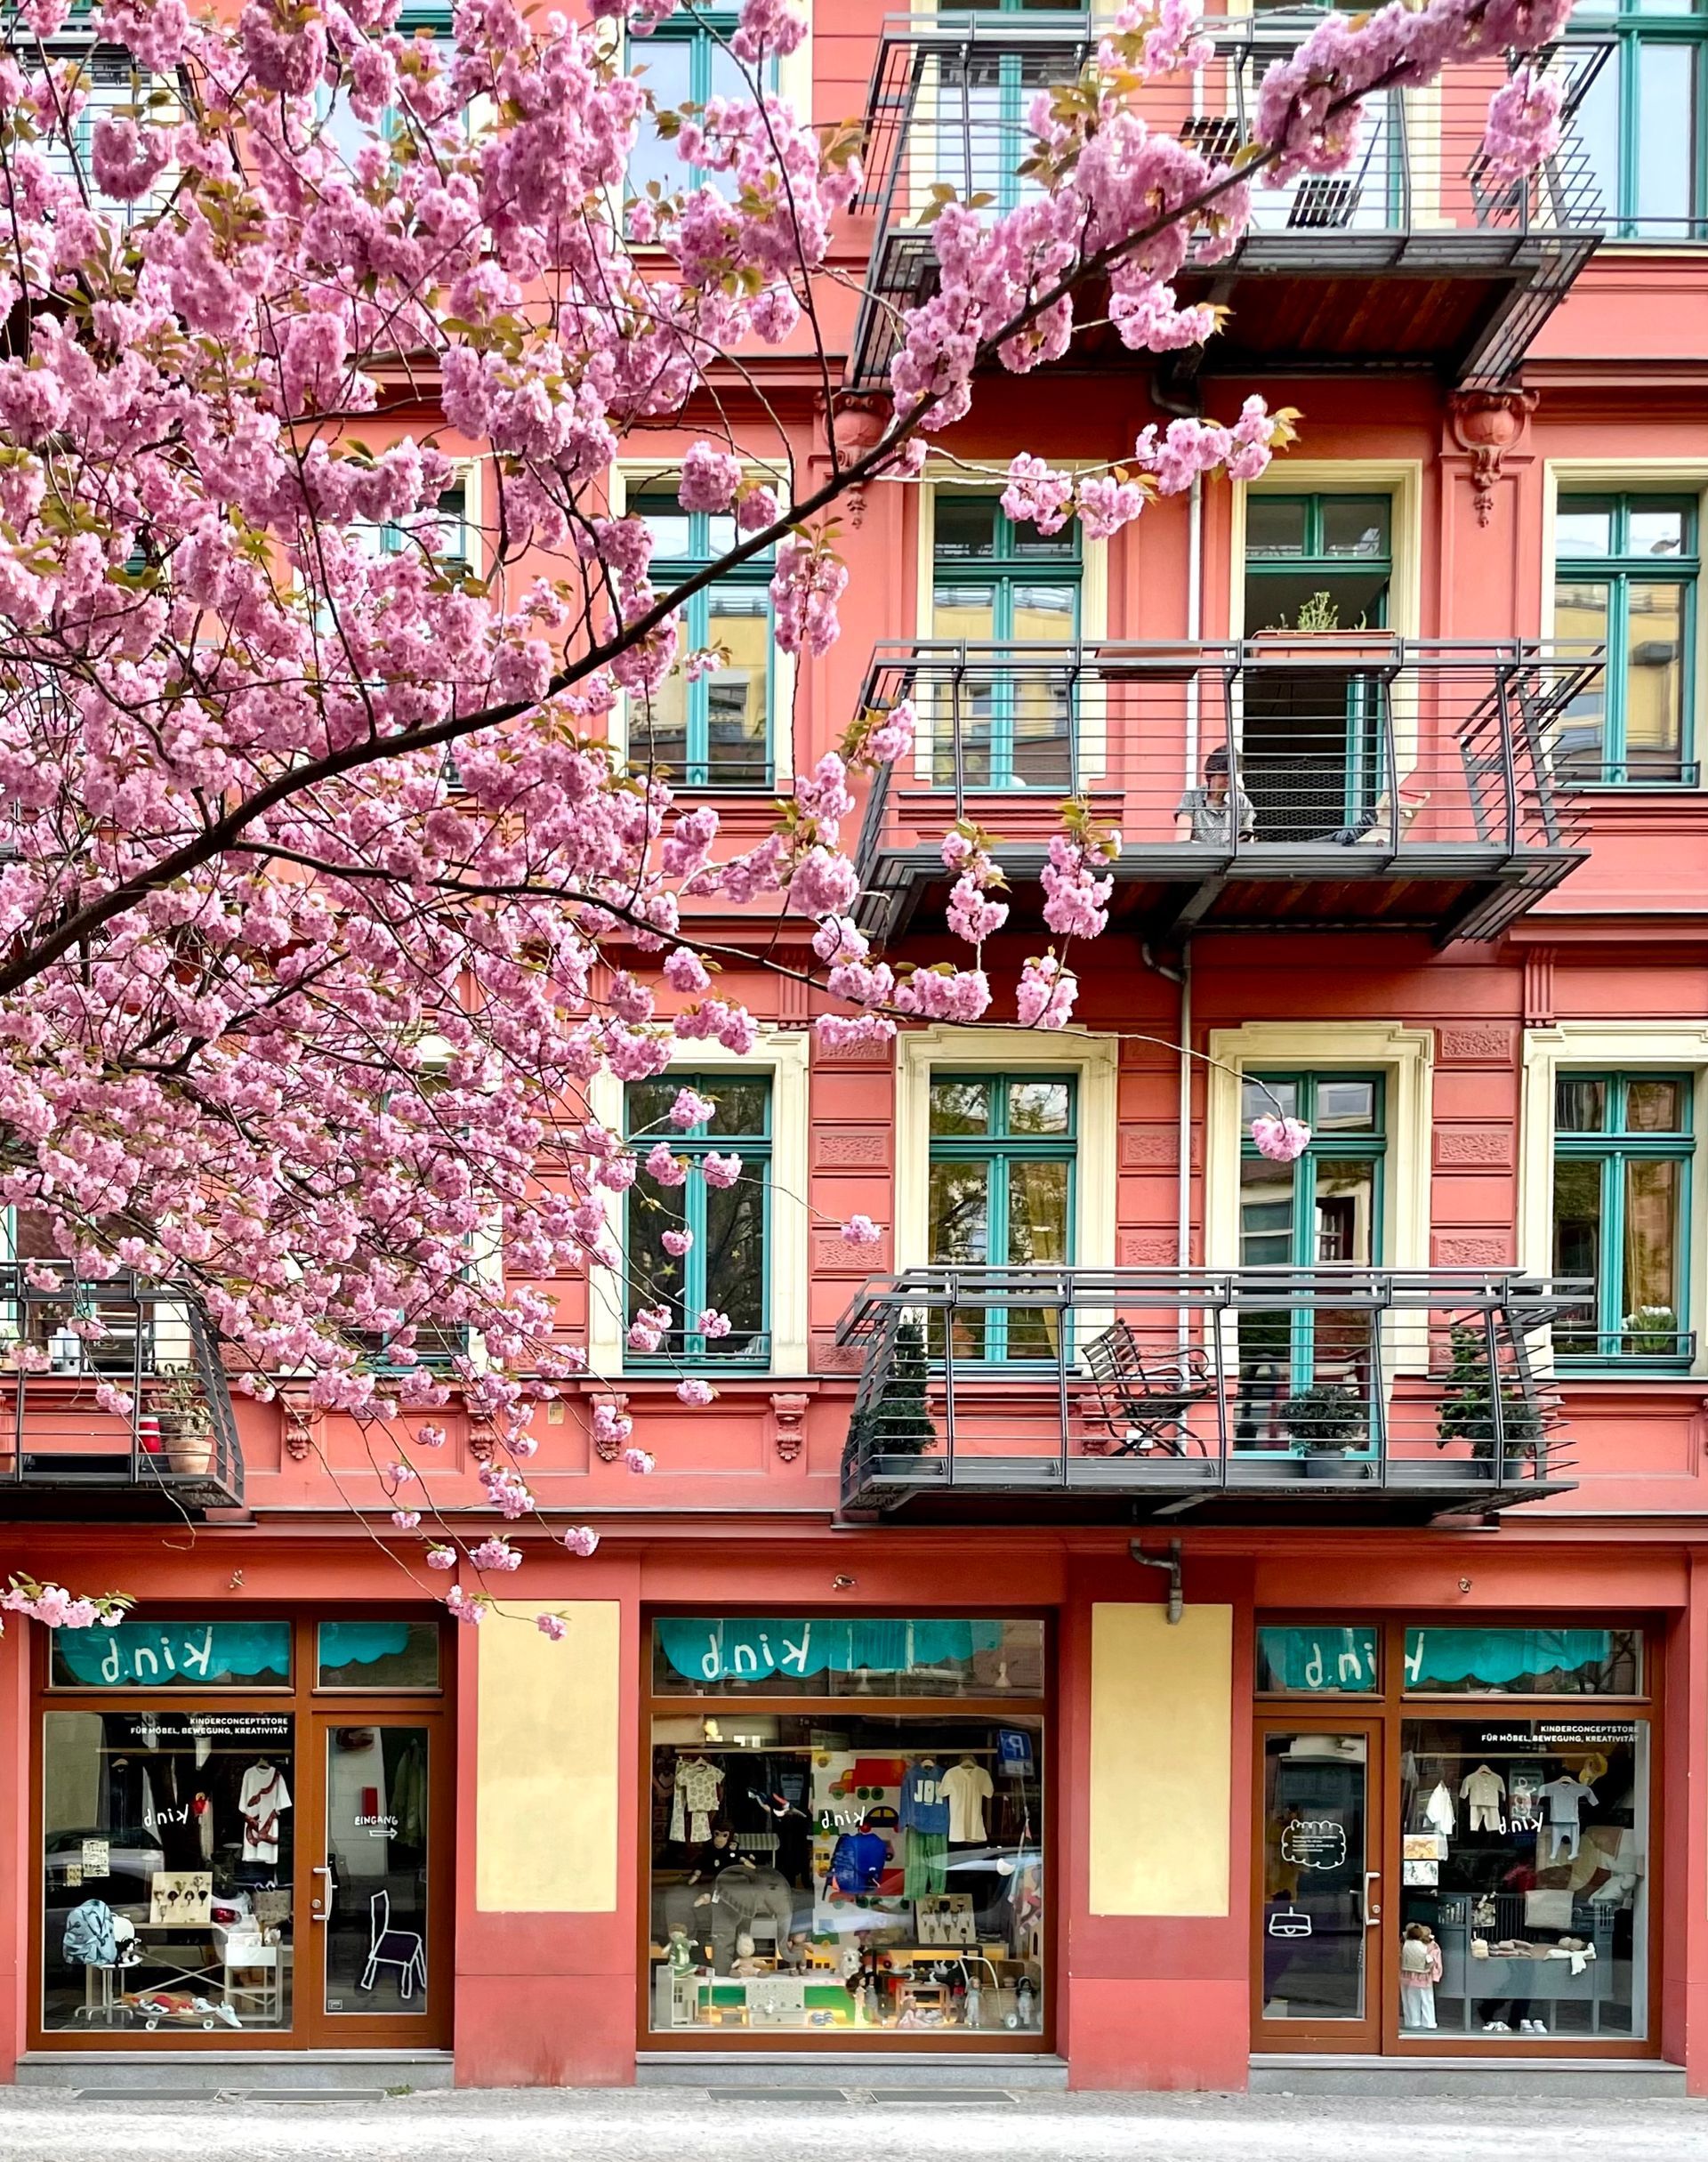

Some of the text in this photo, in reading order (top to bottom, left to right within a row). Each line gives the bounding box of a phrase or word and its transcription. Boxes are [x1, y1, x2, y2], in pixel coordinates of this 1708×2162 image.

[189, 1717, 288, 1725] KINDERCONCEPTSTORE
[130, 1726, 288, 1735] FÜR MÖBEL, BEWEGUNG, KREATIVITÄT
[1540, 1725, 1640, 1733] KINDERCONCEPTSTORE
[1481, 1733, 1640, 1743] FÜR MÖBEL, BEWEGUNG, KREATIVITÄT
[354, 1815, 399, 1826] EINGANG
